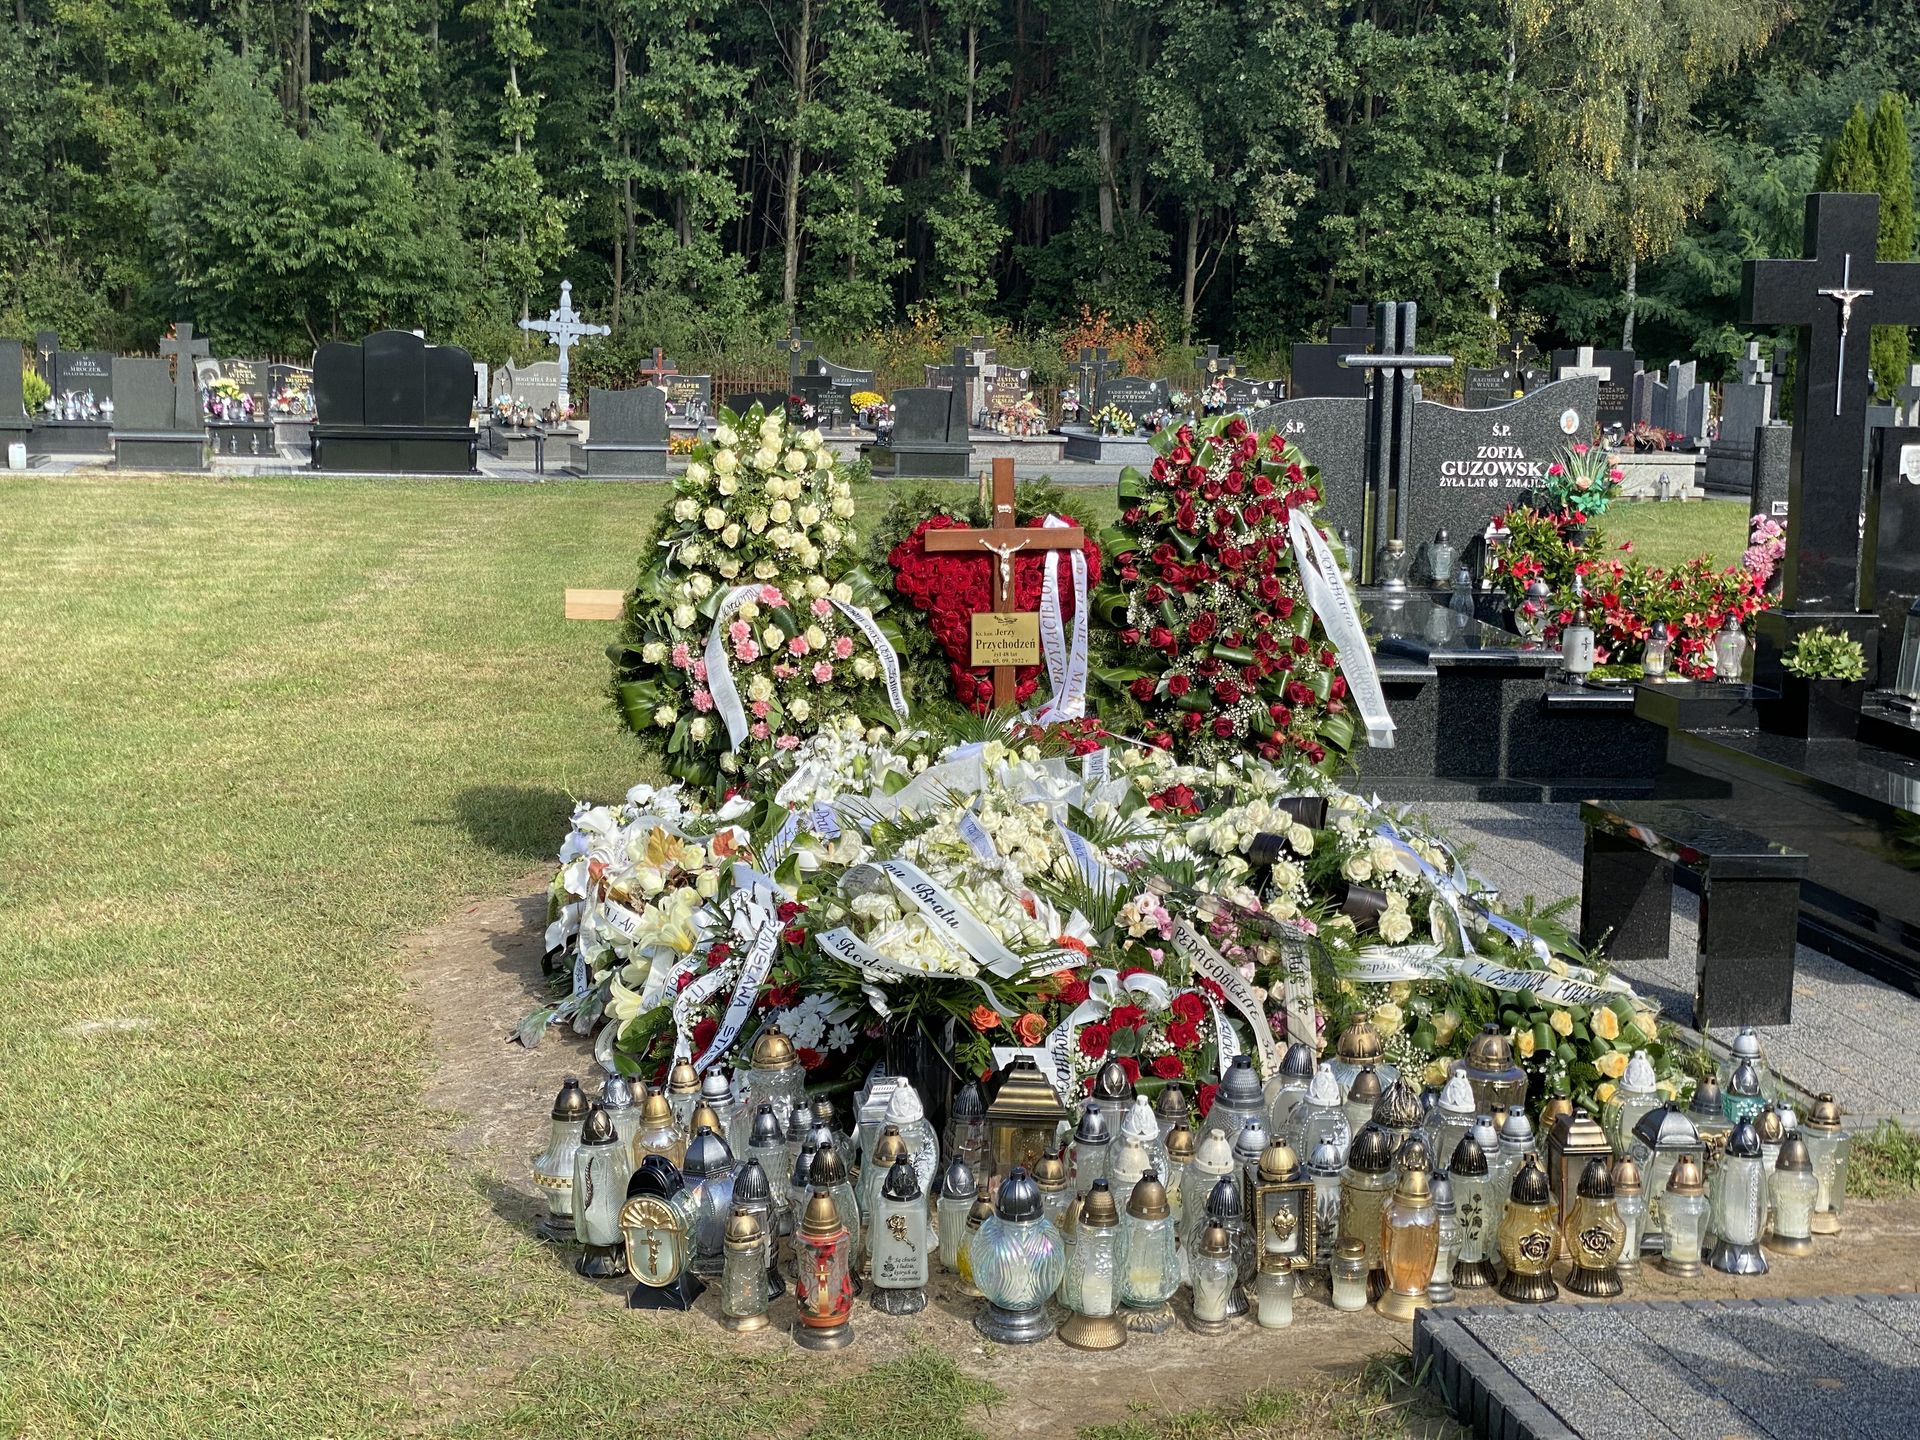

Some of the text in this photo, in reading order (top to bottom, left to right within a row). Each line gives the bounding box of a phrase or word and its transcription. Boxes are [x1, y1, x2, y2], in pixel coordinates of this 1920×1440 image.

[1476, 446, 1525, 459] ZOFIA
[1439, 477, 1465, 488] ŻYŁA
[1467, 478, 1486, 488] LAT
[1488, 478, 1499, 488] 68
[995, 628, 1016, 638] Jerzy
[975, 638, 1036, 652] Przychodzeń
[911, 883, 960, 930] Bratu
